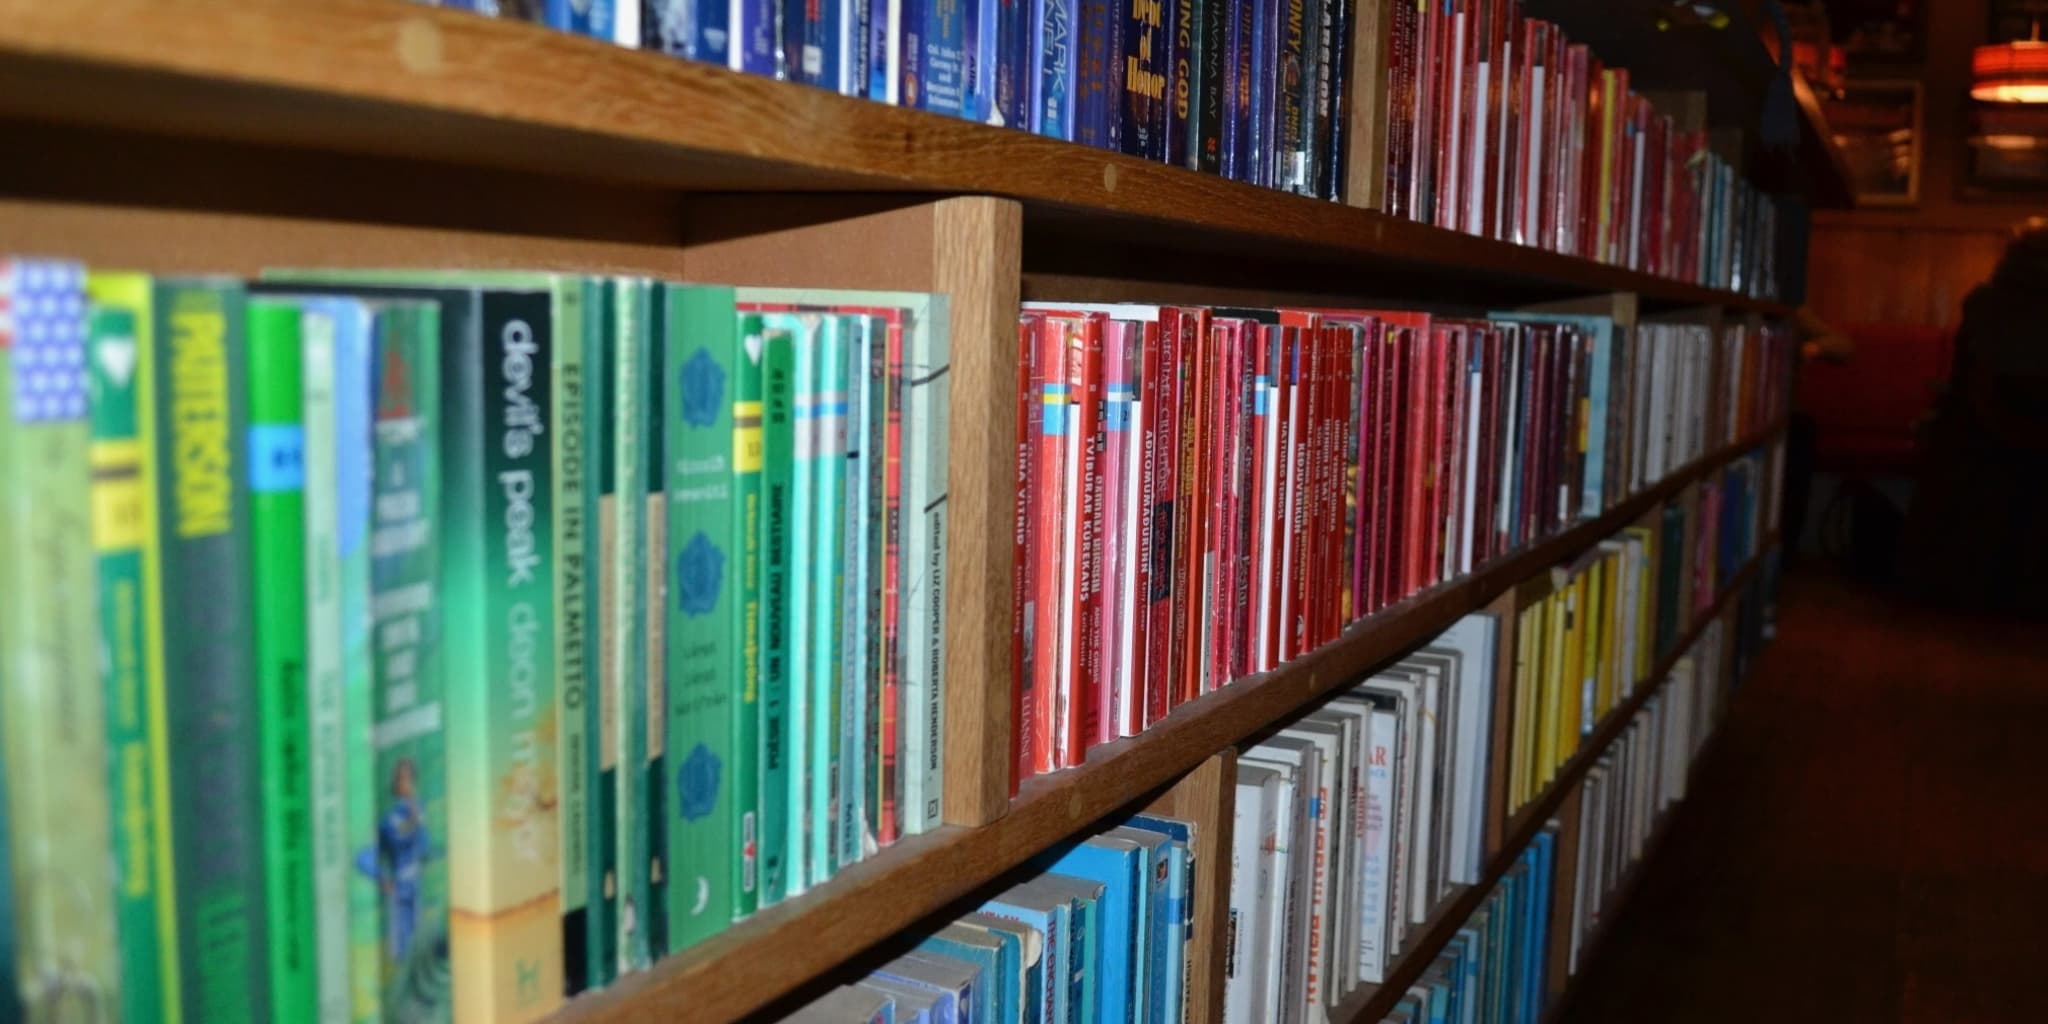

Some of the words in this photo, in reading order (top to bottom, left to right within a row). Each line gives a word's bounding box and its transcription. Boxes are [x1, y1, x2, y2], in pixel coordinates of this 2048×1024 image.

[1209, 1, 1221, 80] HAVANA
[1126, 55, 1166, 100] Honor
[1177, 58, 1190, 120] GOD
[1208, 86, 1217, 119] BAY
[502, 319, 544, 459] devil's
[1160, 329, 1172, 399] MICHAEL
[171, 311, 232, 538] PATTERSON
[561, 362, 584, 493] EPISODE
[1157, 406, 1171, 493] CRICHTON
[1018, 442, 1028, 483] EINA
[1083, 436, 1096, 514] TVÍBURAR
[497, 468, 542, 590] peak
[562, 504, 583, 541] IN
[933, 511, 943, 552] edited
[931, 587, 942, 636] COOPER
[932, 568, 942, 587] LIZ
[508, 601, 542, 719] deon
[562, 552, 586, 710] PALMETTO
[930, 648, 941, 701] ROBERTA
[929, 701, 940, 771] HENDERSON
